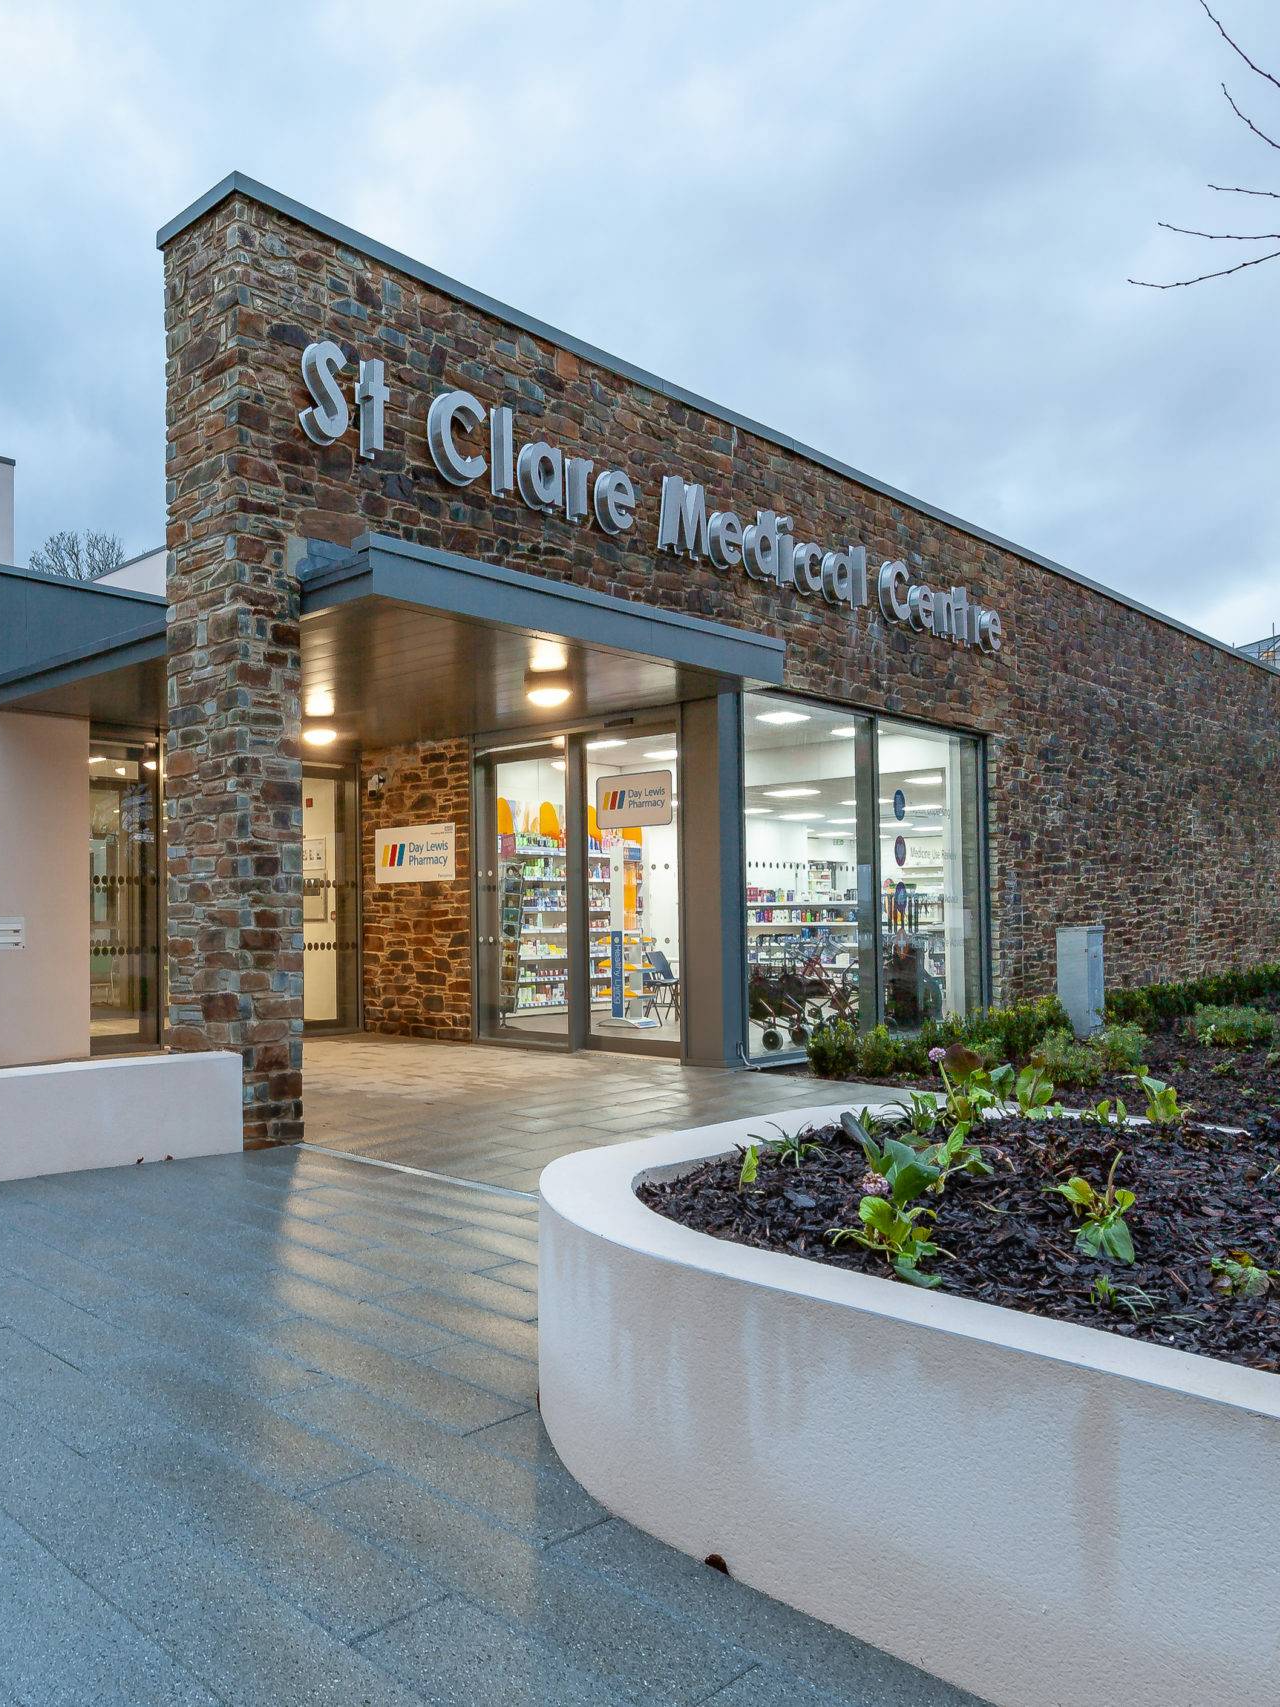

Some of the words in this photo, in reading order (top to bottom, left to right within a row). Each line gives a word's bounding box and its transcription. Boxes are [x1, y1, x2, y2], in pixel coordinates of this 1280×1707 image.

[298, 340, 389, 460] St
[427, 390, 635, 535] Clare
[657, 474, 868, 611] Medical
[877, 560, 1002, 654] Centre
[628, 790, 643, 799] Day
[644, 787, 665, 797] Lewis
[628, 799, 665, 809] Pharmacy
[408, 841, 424, 854] Day
[426, 840, 449, 852] Lewis
[408, 855, 449, 867] Pharmacy
